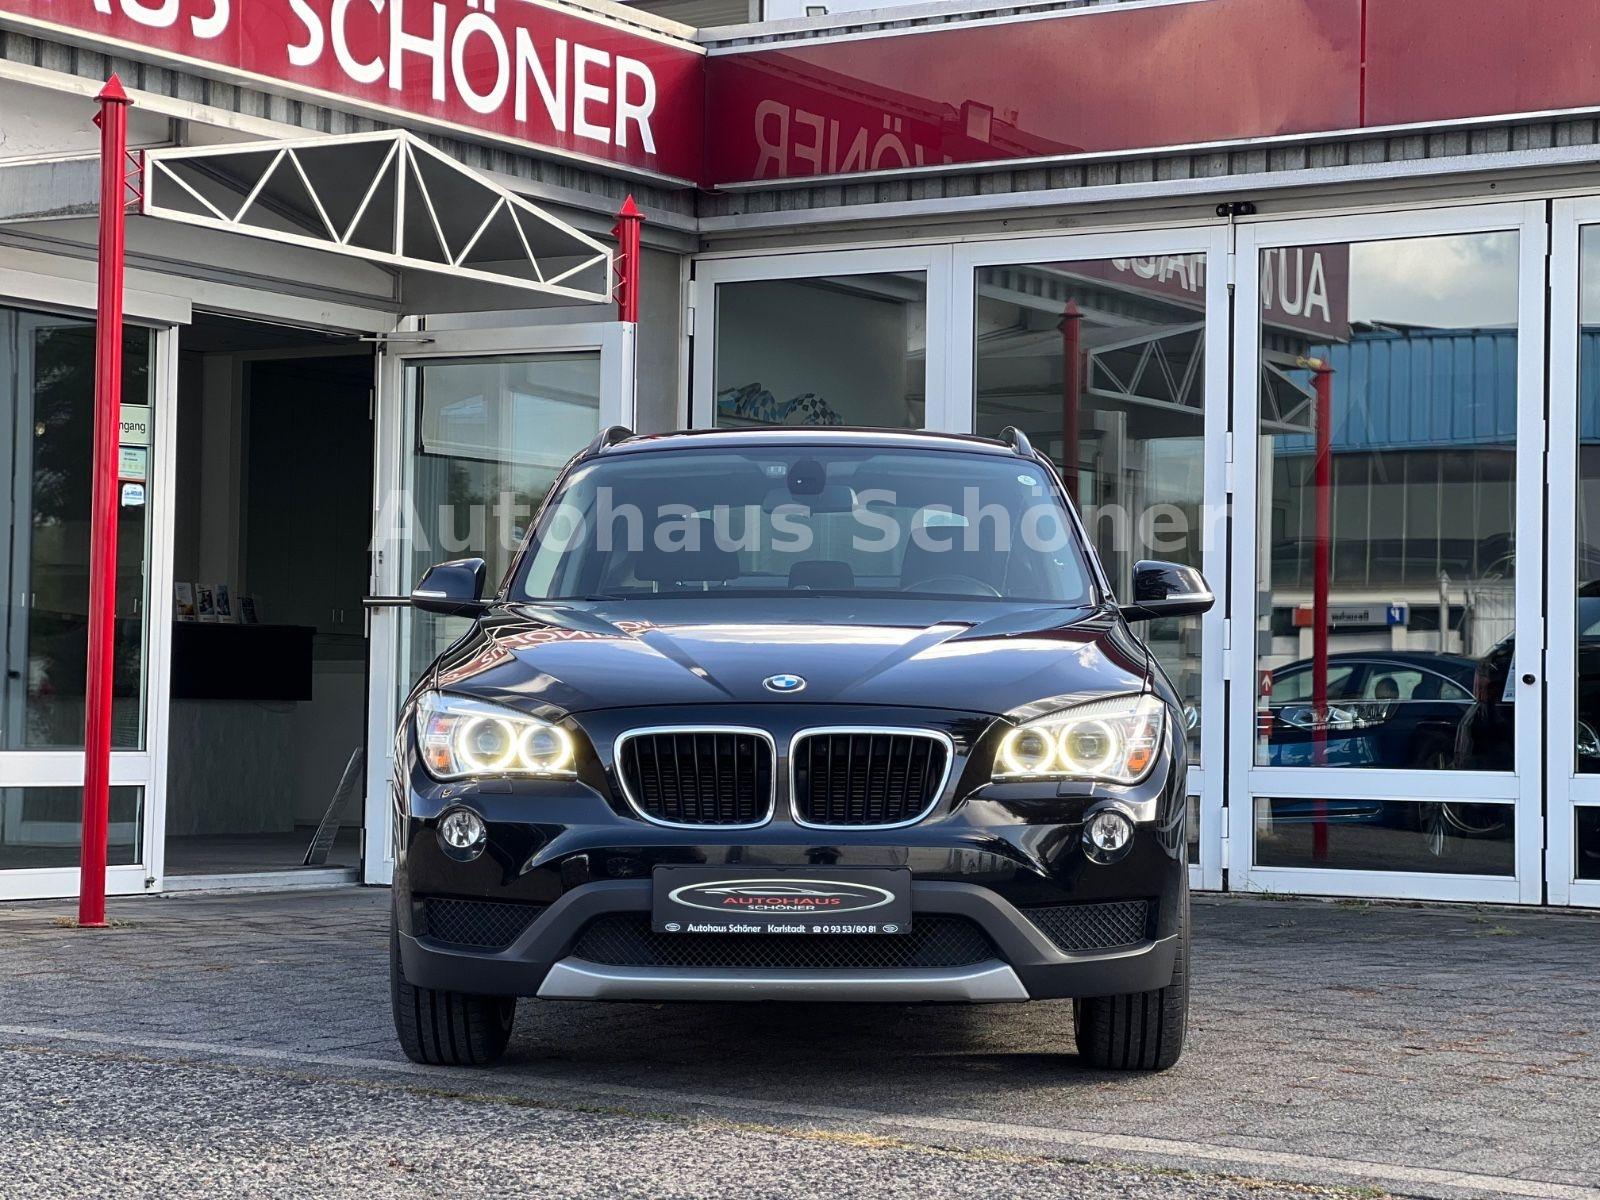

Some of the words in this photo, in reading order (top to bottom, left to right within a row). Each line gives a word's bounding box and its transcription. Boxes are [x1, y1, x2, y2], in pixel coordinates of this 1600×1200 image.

[287, 0, 656, 155] SCHÖNER
[723, 897, 841, 905] AUTOHAUS
[687, 923, 727, 933] Autohaus
[729, 923, 762, 933] Schöner
[767, 924, 806, 933] Karlstadt
